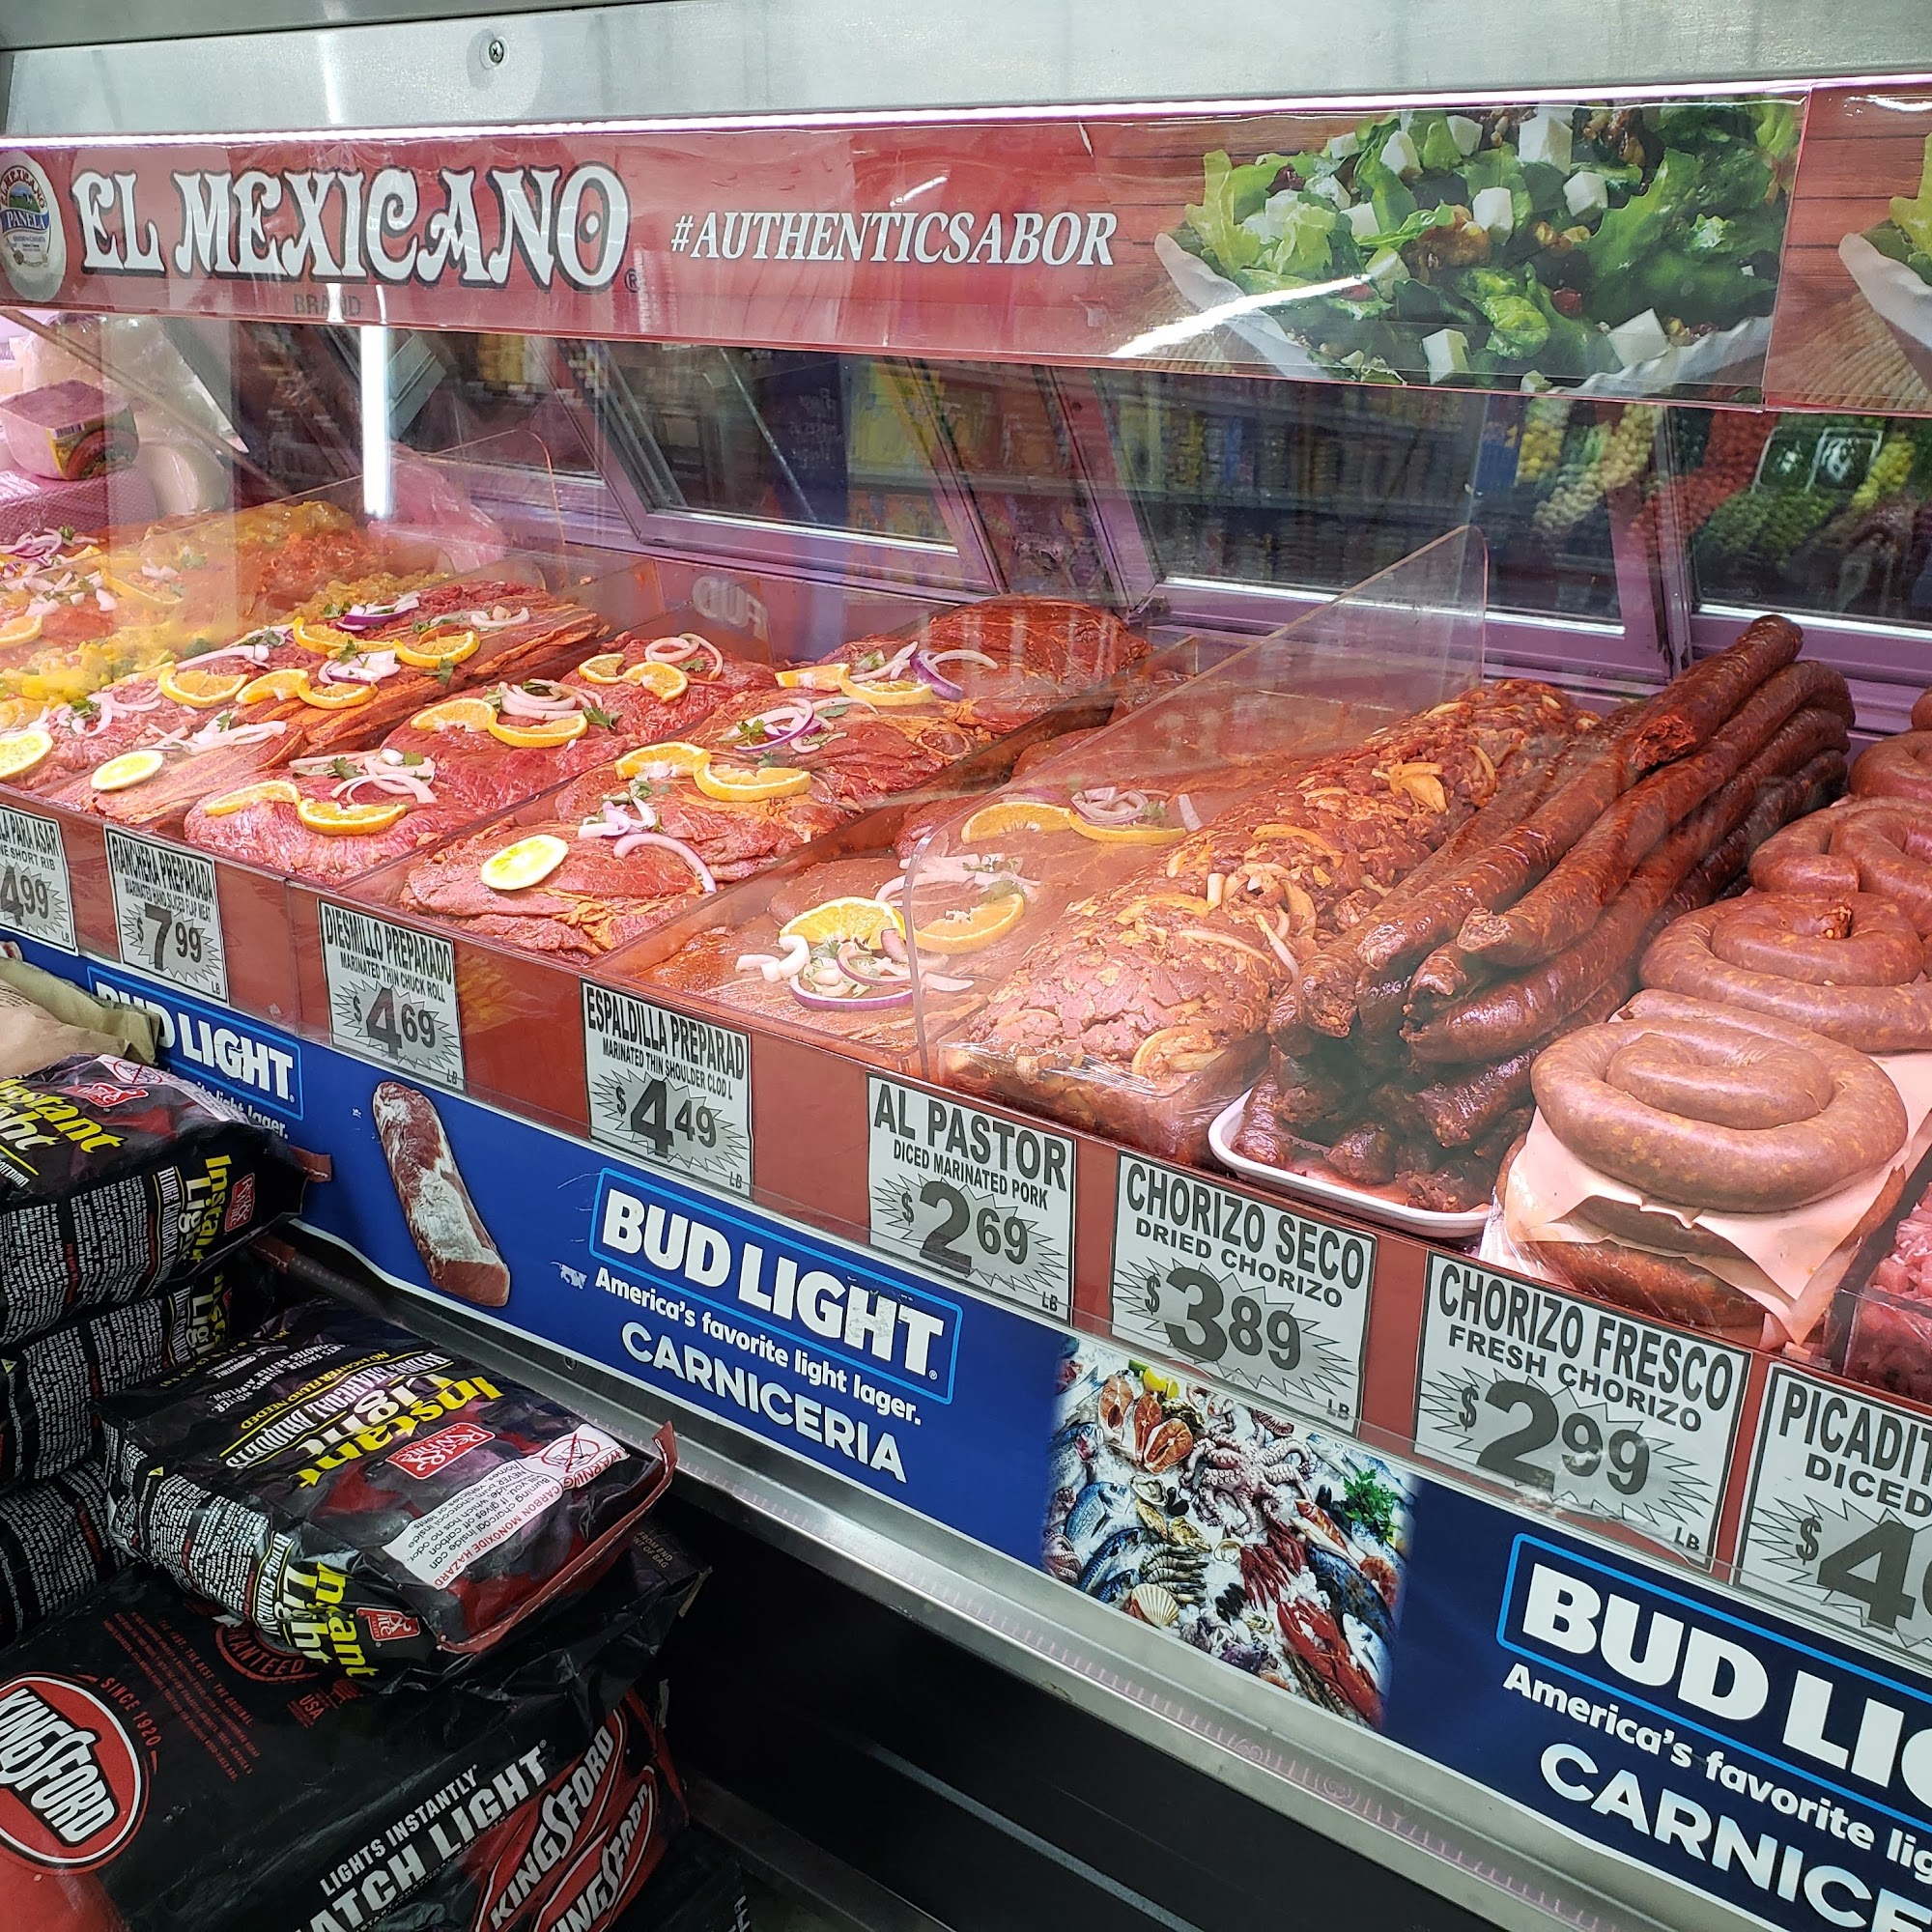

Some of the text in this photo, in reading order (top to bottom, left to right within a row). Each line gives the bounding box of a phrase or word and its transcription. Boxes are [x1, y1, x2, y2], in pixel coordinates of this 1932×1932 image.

[6, 210, 45, 230] PANELA
[70, 160, 632, 292] EL MEXICANO
[669, 212, 1118, 267] #AUTHENTICSABOR
[294, 292, 362, 319] BRAND
[10, 813, 35, 850] PARA
[33, 821, 60, 858] ASAR
[10, 847, 39, 866] SHORT
[41, 856, 56, 870] RIB
[111, 836, 214, 905] RANCHERA PREPARADA
[125, 877, 212, 923] MARINATED HAND SLICED FLAP MEAT
[61, 930, 71, 943] LB
[324, 905, 452, 985] DIESMILLO PREPARADO
[211, 980, 221, 995] LB
[340, 952, 446, 1004] MARINATED THIN CHUCK ROLL
[178, 1012, 294, 1101] LIGHT
[585, 986, 745, 1081] ESPALDILLA PREPARAD
[602, 1037, 645, 1068] MARINATED
[645, 1051, 664, 1076] THIN
[665, 1060, 706, 1090] SHOULDER
[706, 1074, 726, 1097] CLOD
[446, 1068, 459, 1085] LB
[873, 1083, 1067, 1193] AL PASTOR
[729, 1171, 743, 1190] LB
[894, 1138, 1049, 1211] DICED MARINATED PORK
[157, 1166, 181, 1258] RIDGE CHARCOAL
[1126, 1162, 1365, 1291] CHORIZO SECO
[602, 1188, 945, 1377] BUD LIGHT
[1135, 1216, 1343, 1308] DRIED CHORIZO
[1041, 1291, 1059, 1313] LB
[595, 1266, 922, 1426] America's favorite light lager.
[1438, 1264, 1734, 1412] CHORIZO FRESCO
[288, 1376, 325, 1403] FLUID
[621, 1321, 908, 1484] CARNICERIA
[1325, 1399, 1351, 1422] LB
[1448, 1323, 1702, 1433] FRESH CHORIZO
[225, 1412, 318, 1469] BRIQUETS
[241, 1400, 288, 1430] NEEDED
[297, 1374, 456, 1457] Light
[299, 1376, 504, 1489] Instant
[474, 1499, 501, 1522] gives
[1804, 1452, 1932, 1519] DICED
[265, 1532, 293, 1573] RIDGE
[427, 1525, 463, 1556] carbon
[428, 1475, 551, 1571] Burning charcoal inside can
[429, 1528, 444, 1543] no
[432, 1484, 561, 1588] CARBON MONOXIDE HAZARD
[1673, 1526, 1701, 1551] LB
[1522, 1562, 1769, 1721] BUD
[99, 1677, 162, 1747] SINCE 1920
[298, 1693, 326, 1719] USA
[0, 1688, 116, 1843] KINGSFORD
[1502, 1662, 1693, 1769] America's
[1705, 1749, 1875, 1851] favorite
[294, 1746, 547, 1932] ATCH LIGHT
[320, 1766, 476, 1897] LIGHTS INSTANTLY
[490, 1725, 613, 1930] KINGSFORD
